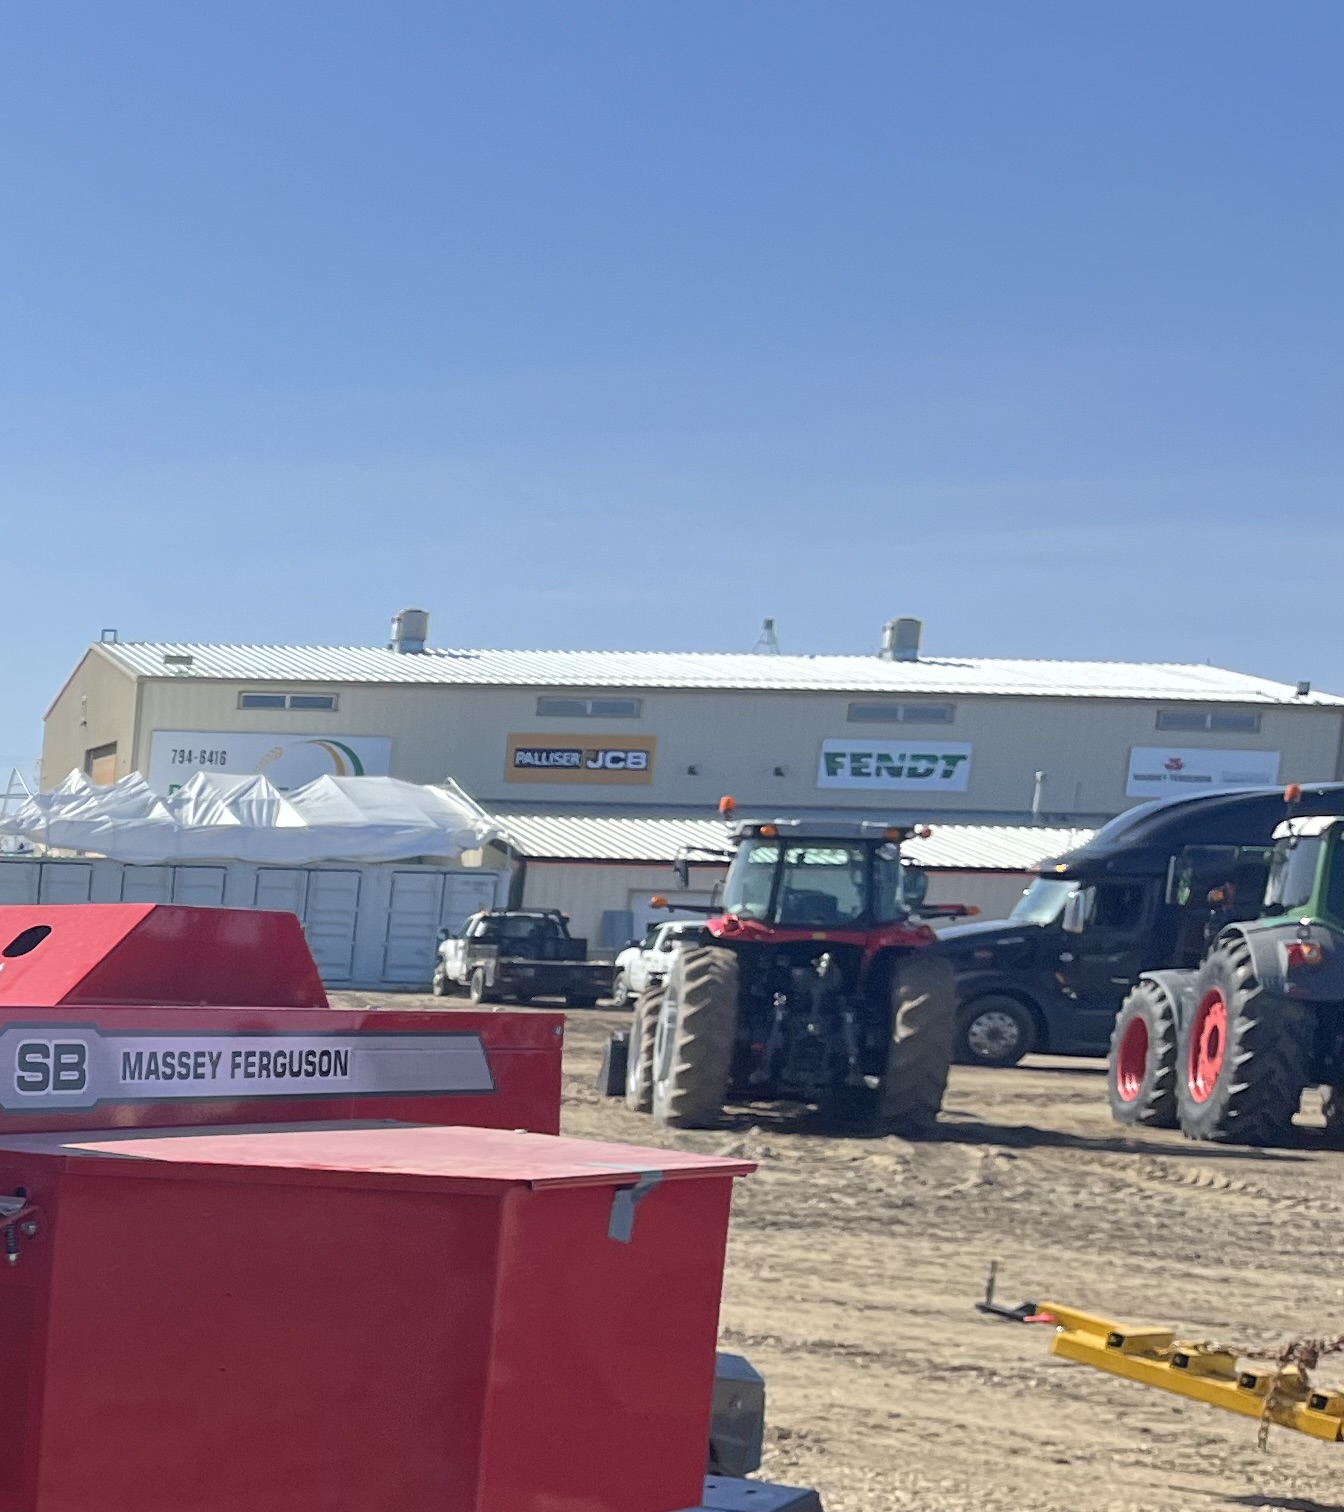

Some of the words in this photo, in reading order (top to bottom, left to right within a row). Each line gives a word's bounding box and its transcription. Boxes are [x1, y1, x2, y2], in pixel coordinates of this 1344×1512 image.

[170, 748, 227, 766] 794-6416
[515, 750, 581, 767] PALLISER
[586, 750, 648, 769] JCB
[824, 752, 968, 779] FENDT
[16, 1042, 87, 1092] SB
[121, 1050, 223, 1081] MASSEY
[230, 1049, 349, 1079] FERGUSON
